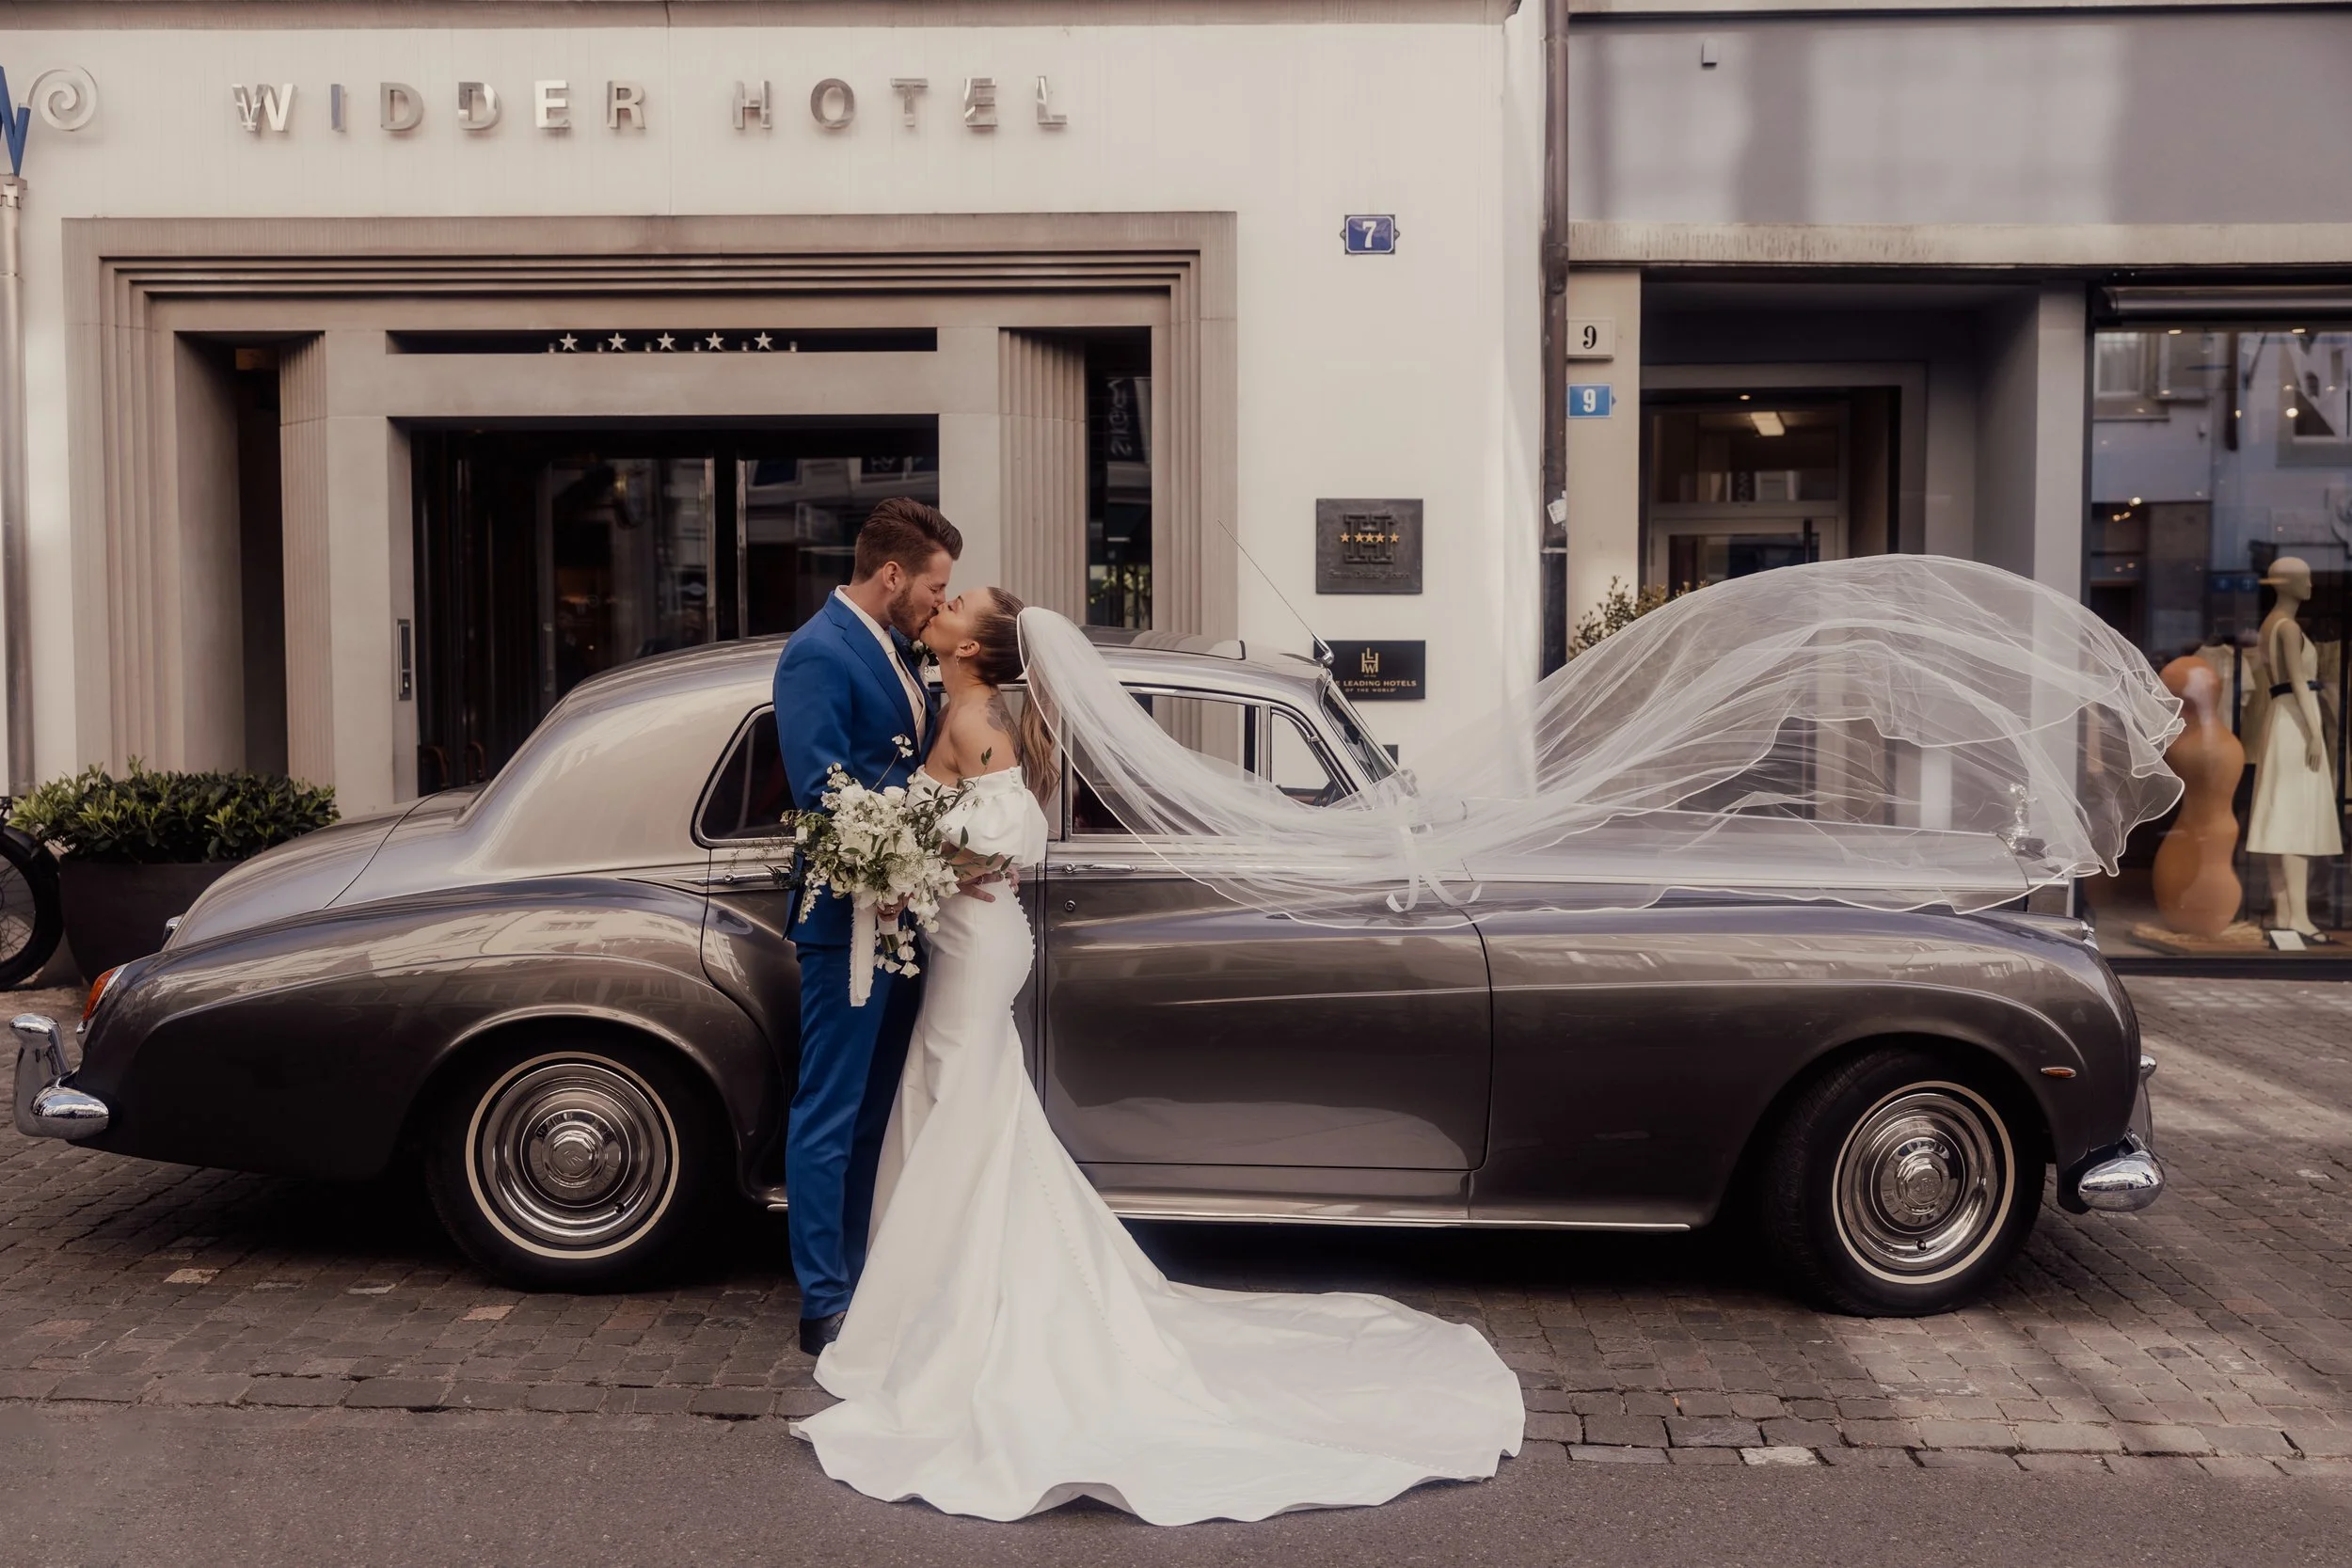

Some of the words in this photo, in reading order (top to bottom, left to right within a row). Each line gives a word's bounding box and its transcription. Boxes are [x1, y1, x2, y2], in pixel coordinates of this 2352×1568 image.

[232, 79, 646, 133] WIDDER
[732, 75, 1068, 131] HOTEL
[1362, 221, 1377, 248] 7
[1583, 325, 1597, 349] 9
[1583, 389, 1597, 413] 9
